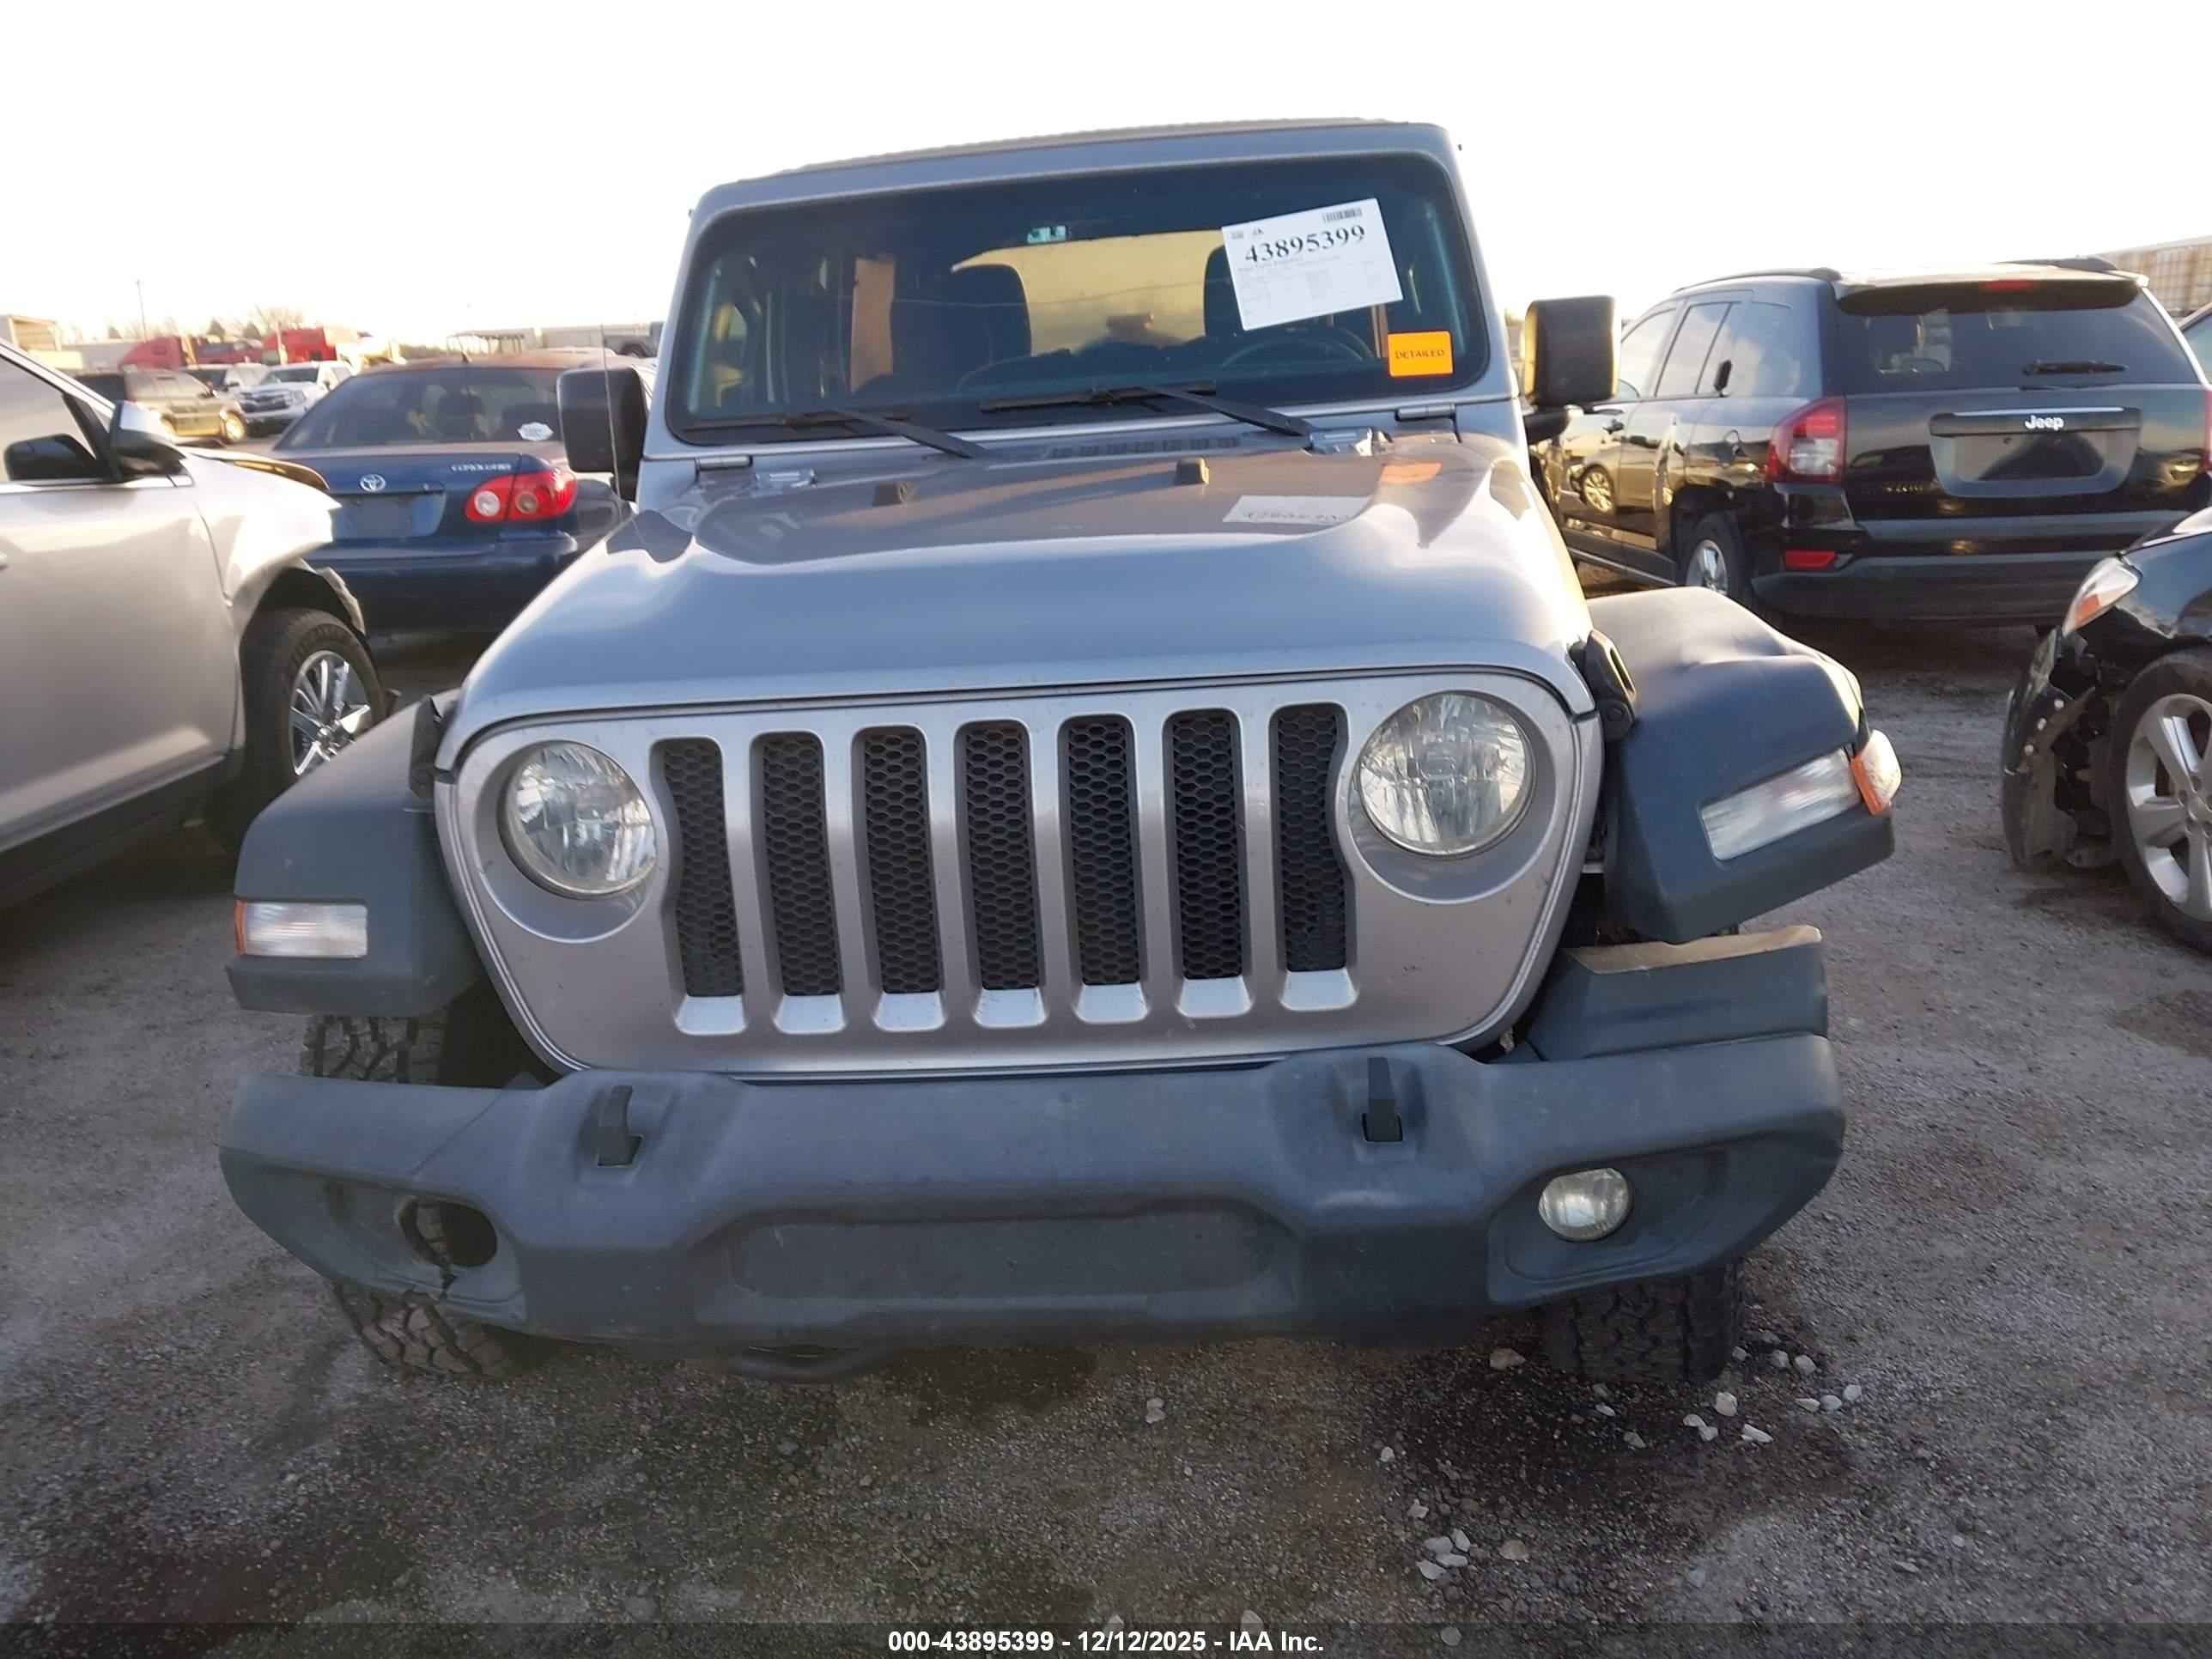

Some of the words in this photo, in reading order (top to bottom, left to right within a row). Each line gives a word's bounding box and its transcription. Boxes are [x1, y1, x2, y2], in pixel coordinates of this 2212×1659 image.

[1245, 223, 1365, 264] 43895399
[1395, 349, 1444, 359] DETAILED
[2025, 415, 2064, 431] Jeep
